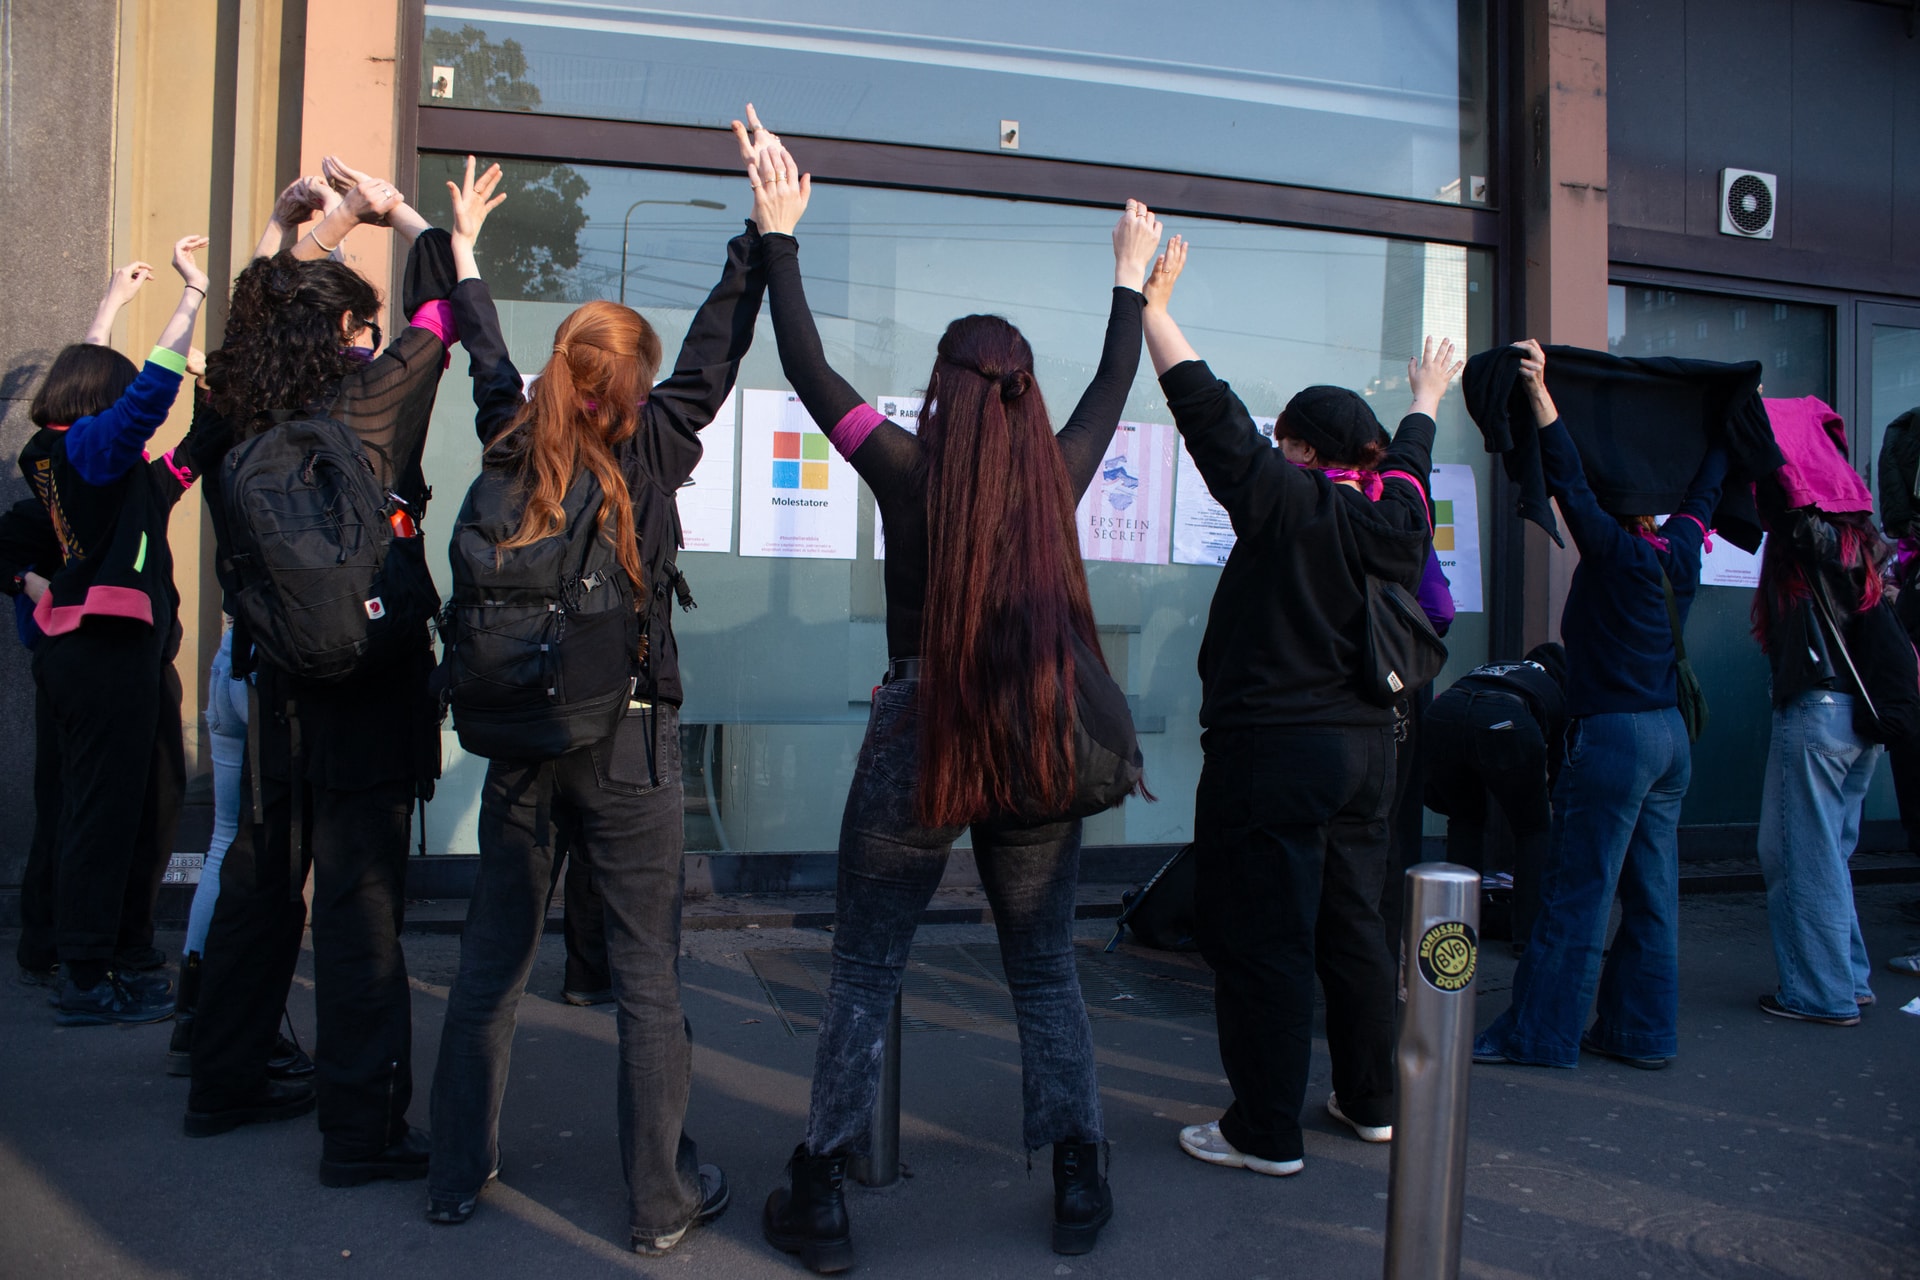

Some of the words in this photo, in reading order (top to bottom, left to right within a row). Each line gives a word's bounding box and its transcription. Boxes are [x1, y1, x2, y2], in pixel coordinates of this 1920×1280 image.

[899, 409, 919, 418] RABB
[771, 497, 829, 507] Molestatore
[1090, 515, 1150, 530] EPSTEIN
[1093, 528, 1146, 542] SECRET
[1420, 923, 1464, 958] BORUSSIA
[1436, 941, 1466, 969] BVB
[1435, 946, 1477, 989] DORTMUND
